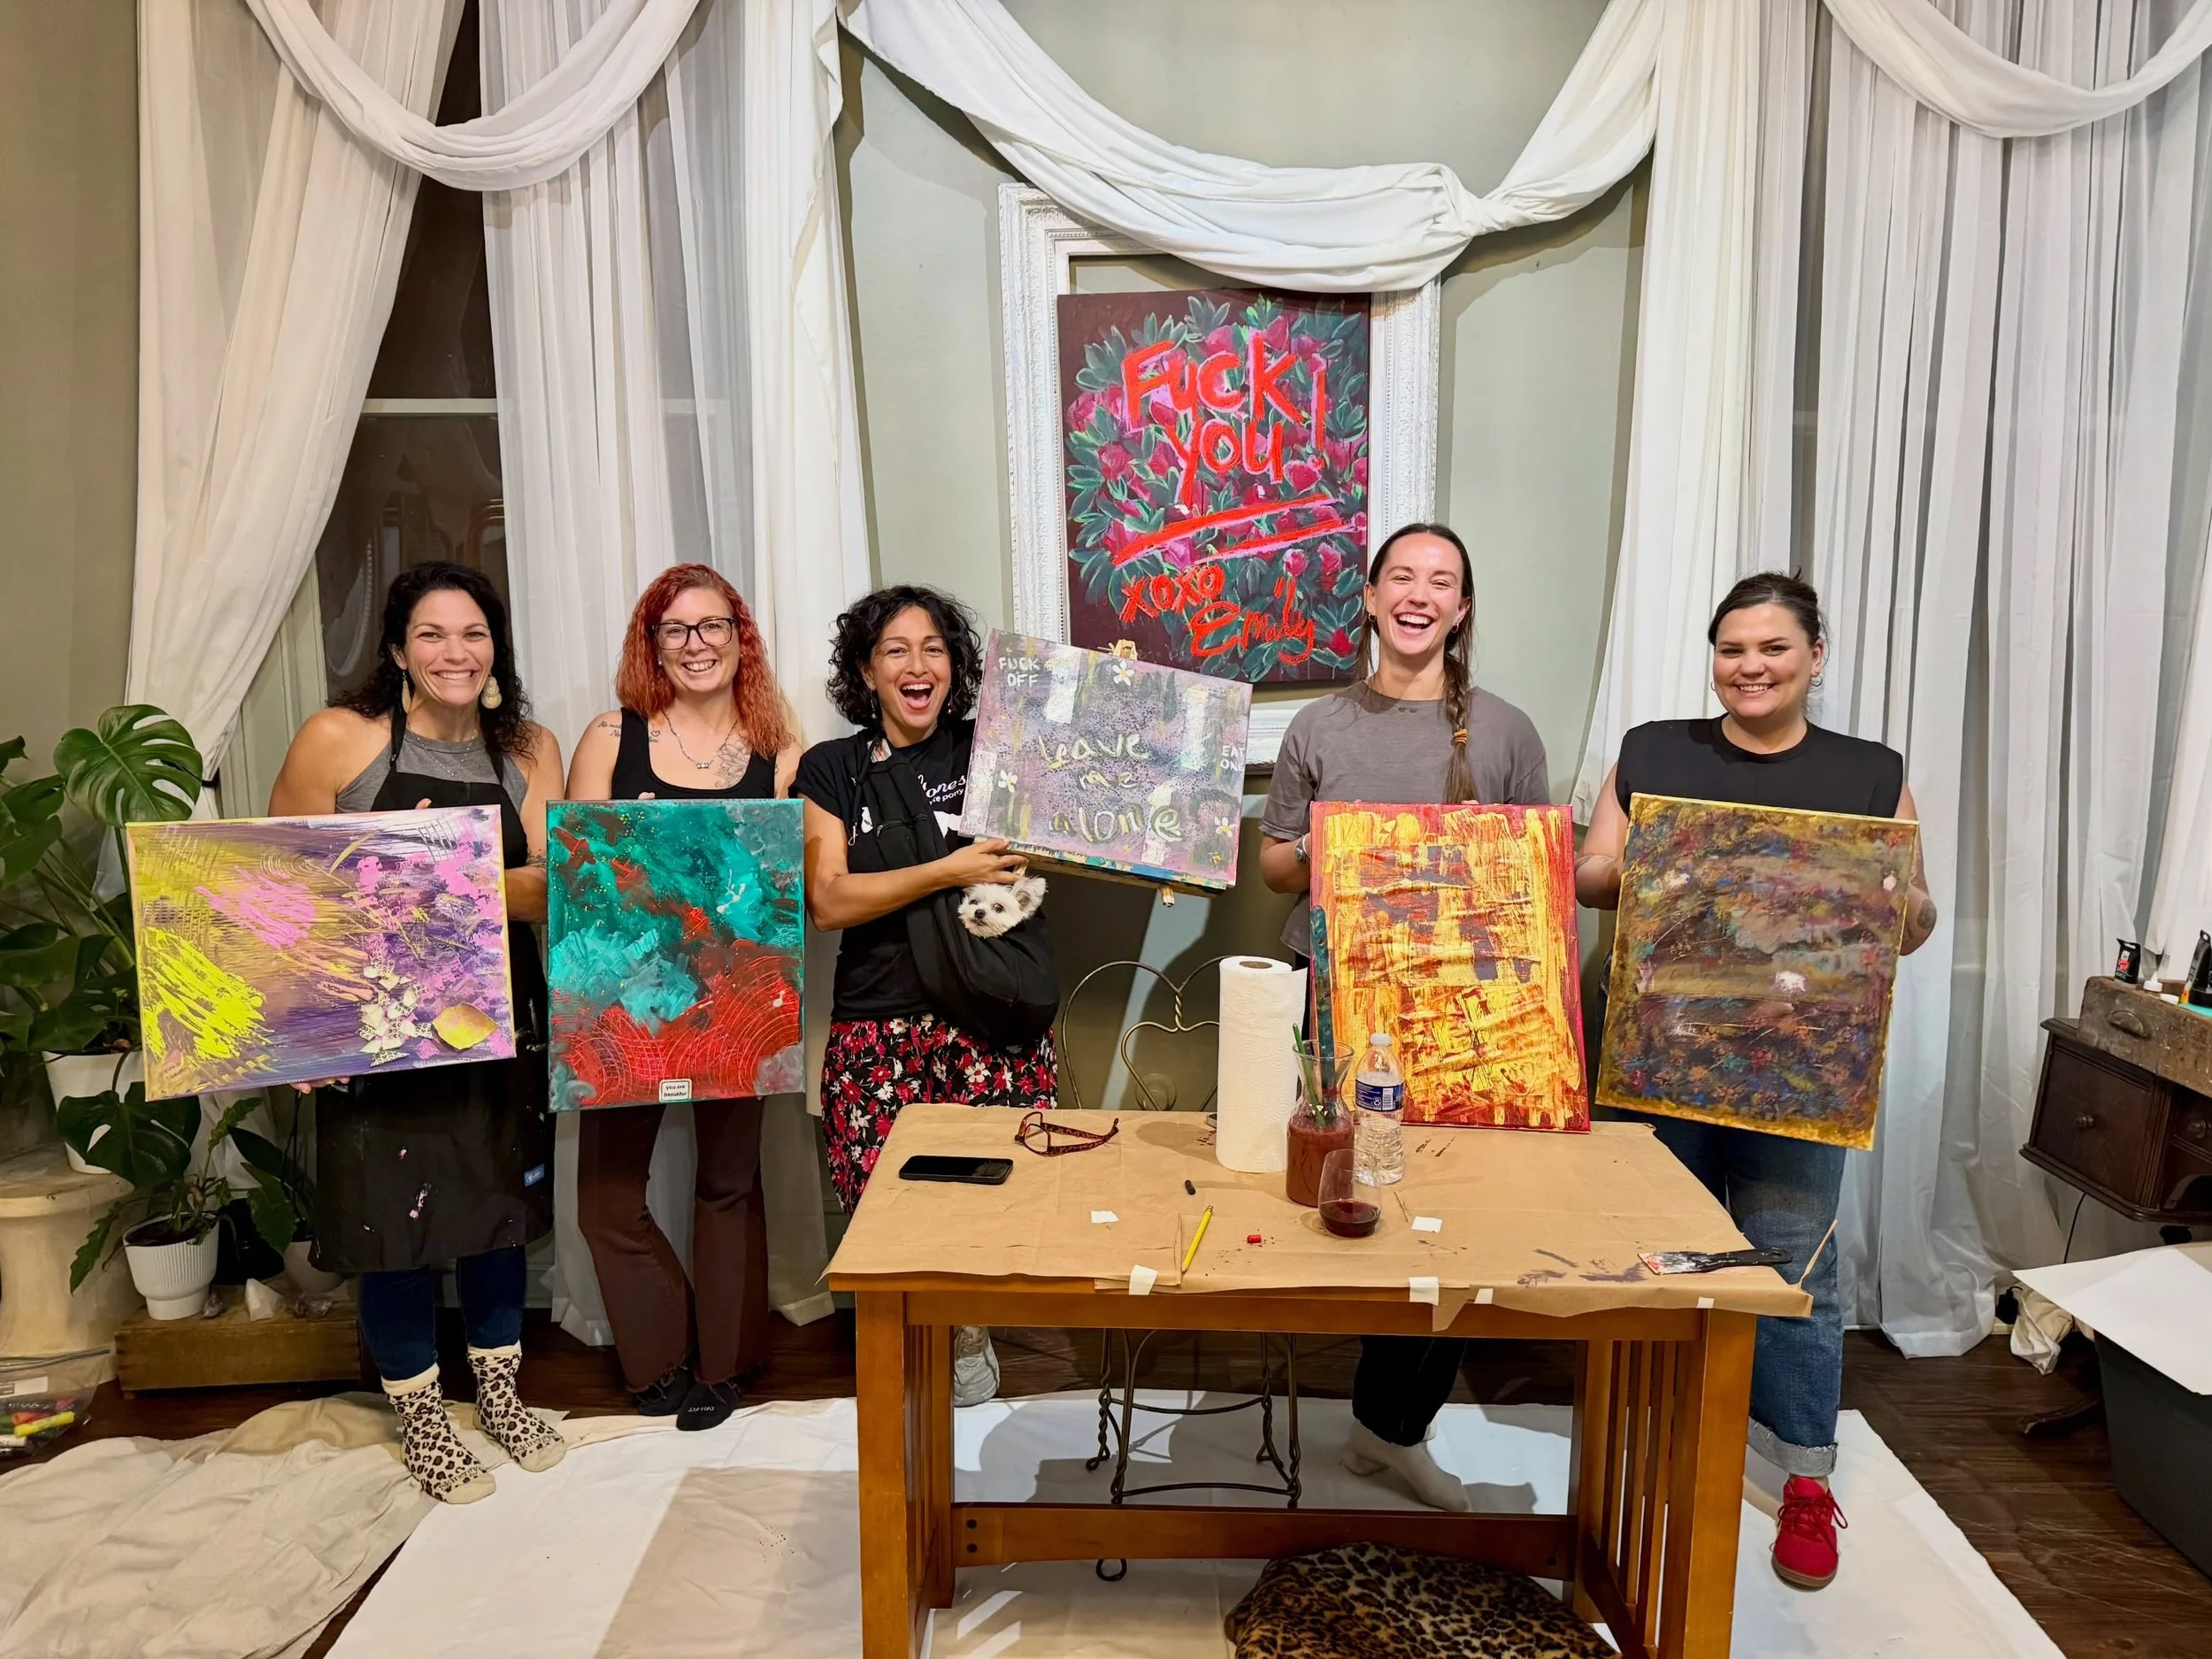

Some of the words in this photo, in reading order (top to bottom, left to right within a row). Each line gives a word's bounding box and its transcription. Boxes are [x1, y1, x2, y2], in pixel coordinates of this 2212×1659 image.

[1188, 578, 1315, 665] Emily
[998, 657, 1041, 672] FUCK
[1007, 672, 1039, 687] OFF
[1079, 769, 1141, 790] me
[942, 788, 964, 803] pony
